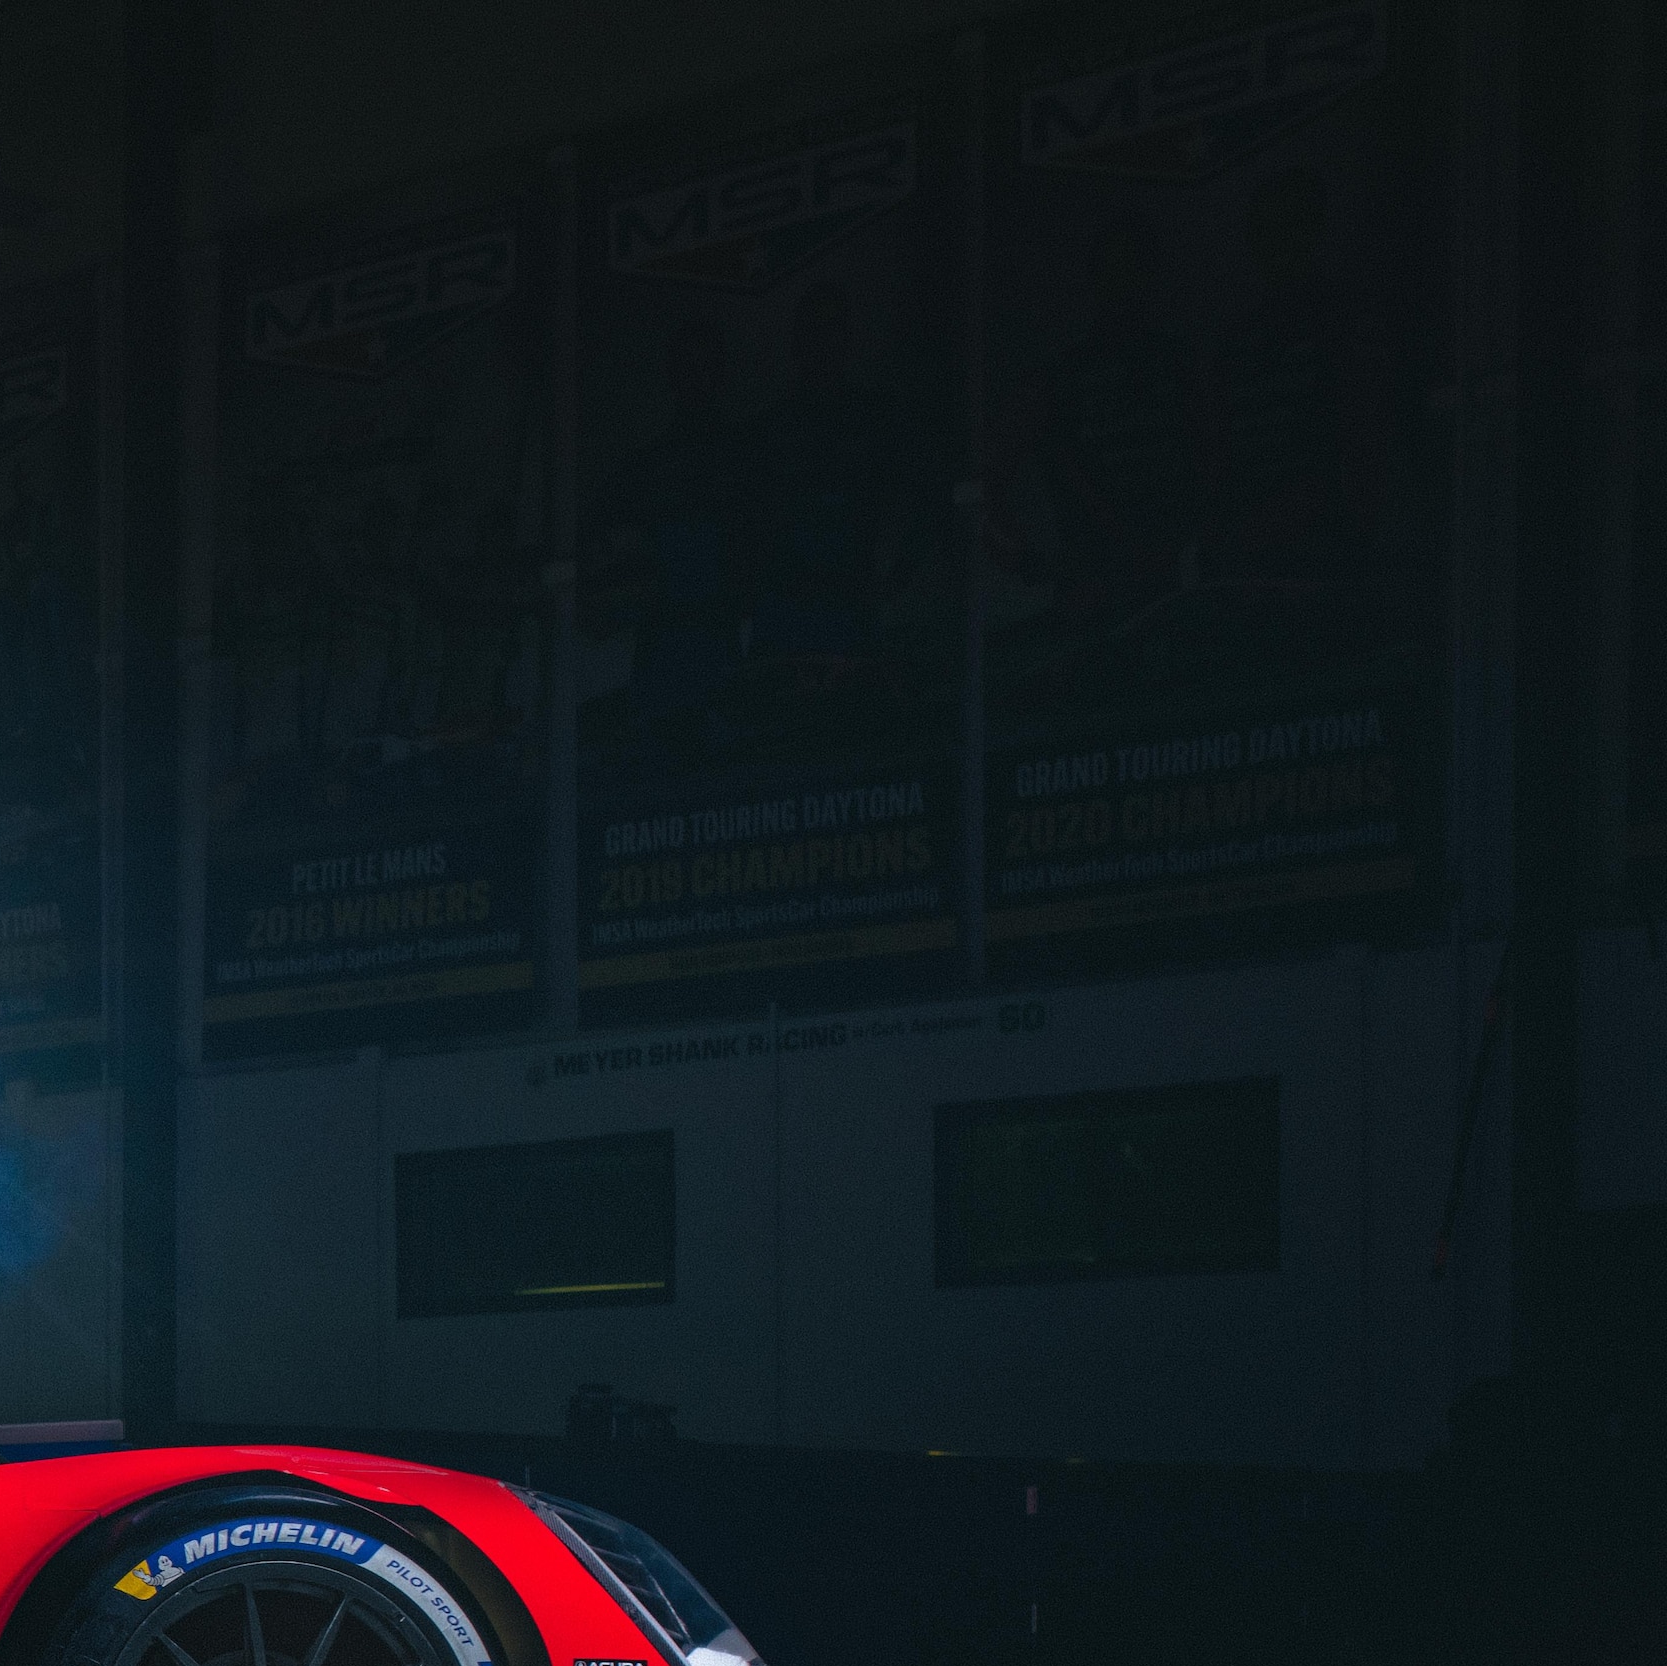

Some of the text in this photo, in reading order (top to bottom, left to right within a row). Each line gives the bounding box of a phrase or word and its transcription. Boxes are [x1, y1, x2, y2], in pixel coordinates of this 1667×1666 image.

[1030, 11, 1374, 149] MSR
[615, 136, 906, 257] MSR
[252, 240, 508, 343] MSR
[1017, 707, 1383, 797] GRAND TOURING DAYTONA
[606, 781, 925, 857] GRAND TOURING DAYTONA
[1005, 755, 1396, 856] 2020 CHAMPIONS
[293, 842, 447, 893] PETIT LE MANS
[598, 826, 932, 911] 2019 CHAMPIONS
[245, 880, 491, 948] 2016 WINNERS
[592, 920, 632, 945] IMSA
[735, 898, 815, 931] SportsCar
[819, 885, 940, 918] Championship
[554, 1047, 643, 1079] MEYER
[649, 1034, 740, 1067] SHANK
[747, 1023, 848, 1057] RACING
[183, 1521, 474, 1648] MICHELIN PILOT SPORT
